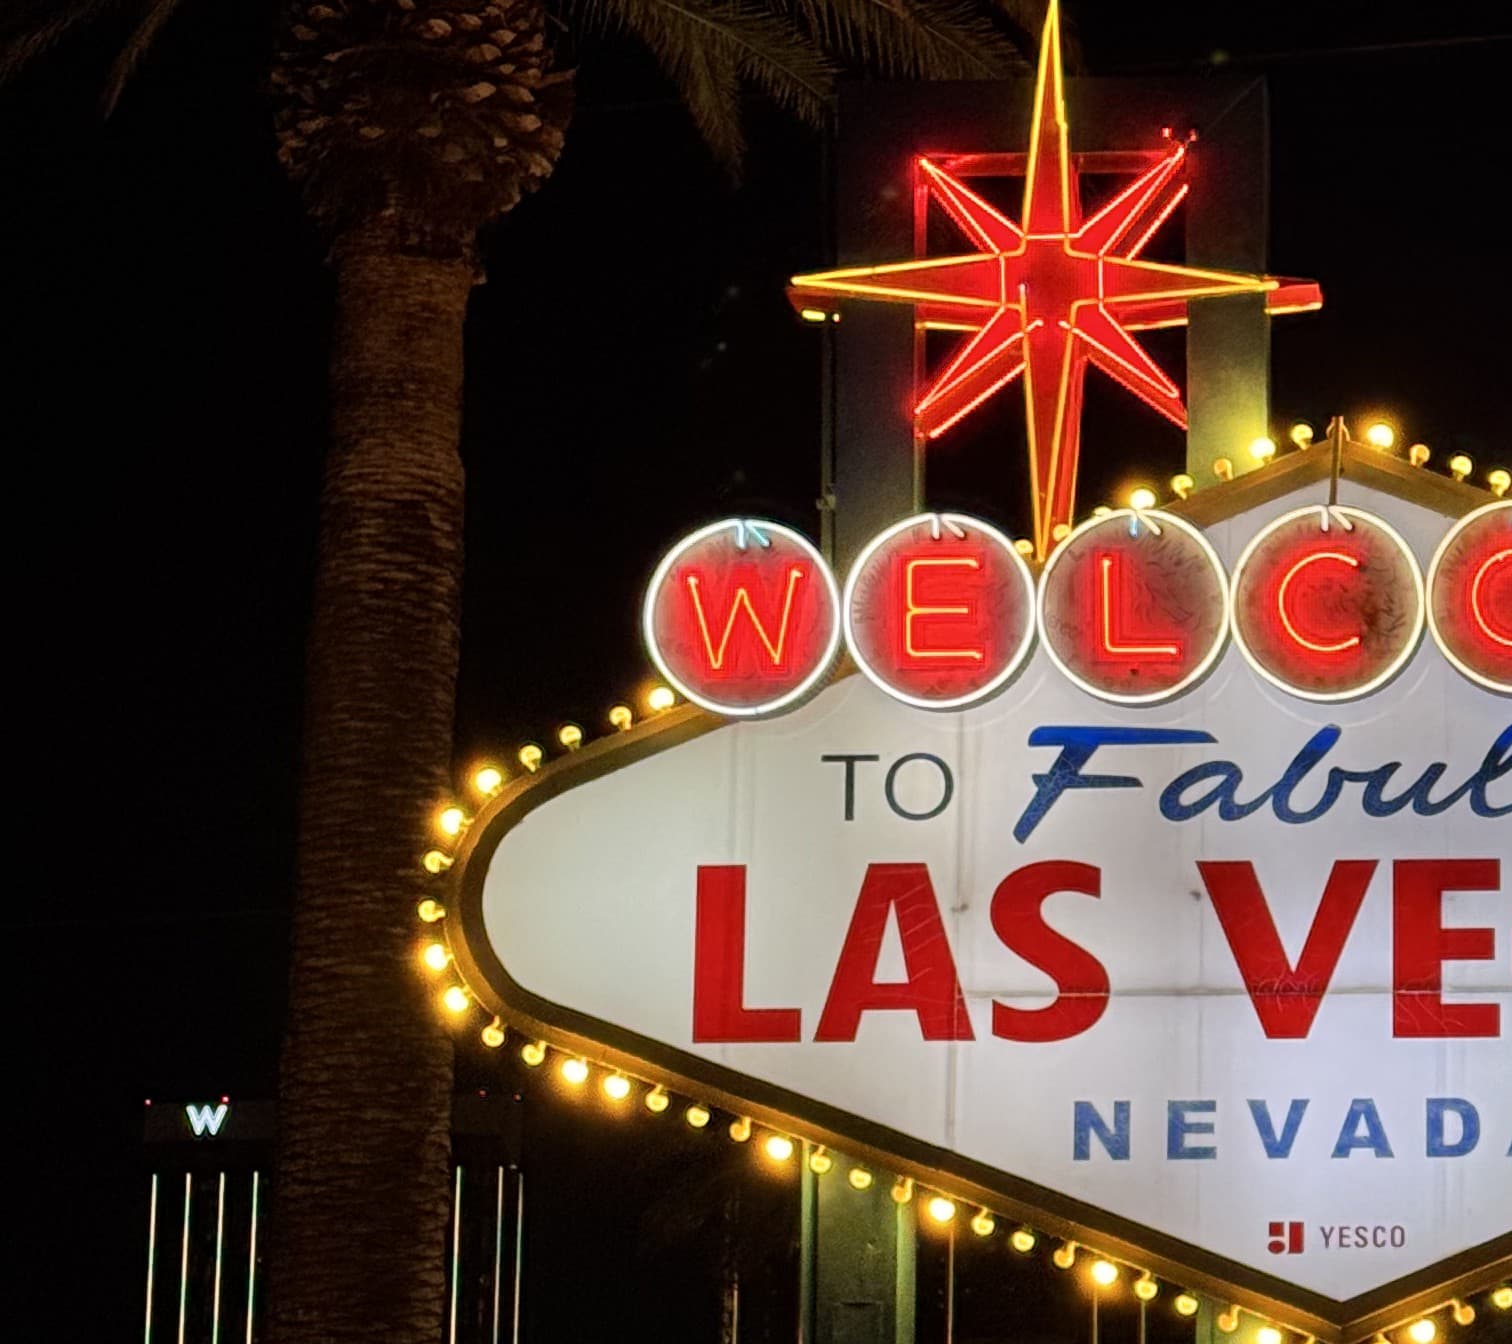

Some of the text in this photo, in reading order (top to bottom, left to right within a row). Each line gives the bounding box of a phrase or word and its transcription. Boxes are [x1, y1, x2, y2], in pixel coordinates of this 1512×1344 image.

[822, 753, 953, 822] TO
[692, 861, 1110, 1044] LAS
[185, 1104, 228, 1136] W
[1319, 1225, 1406, 1248] YESCO
